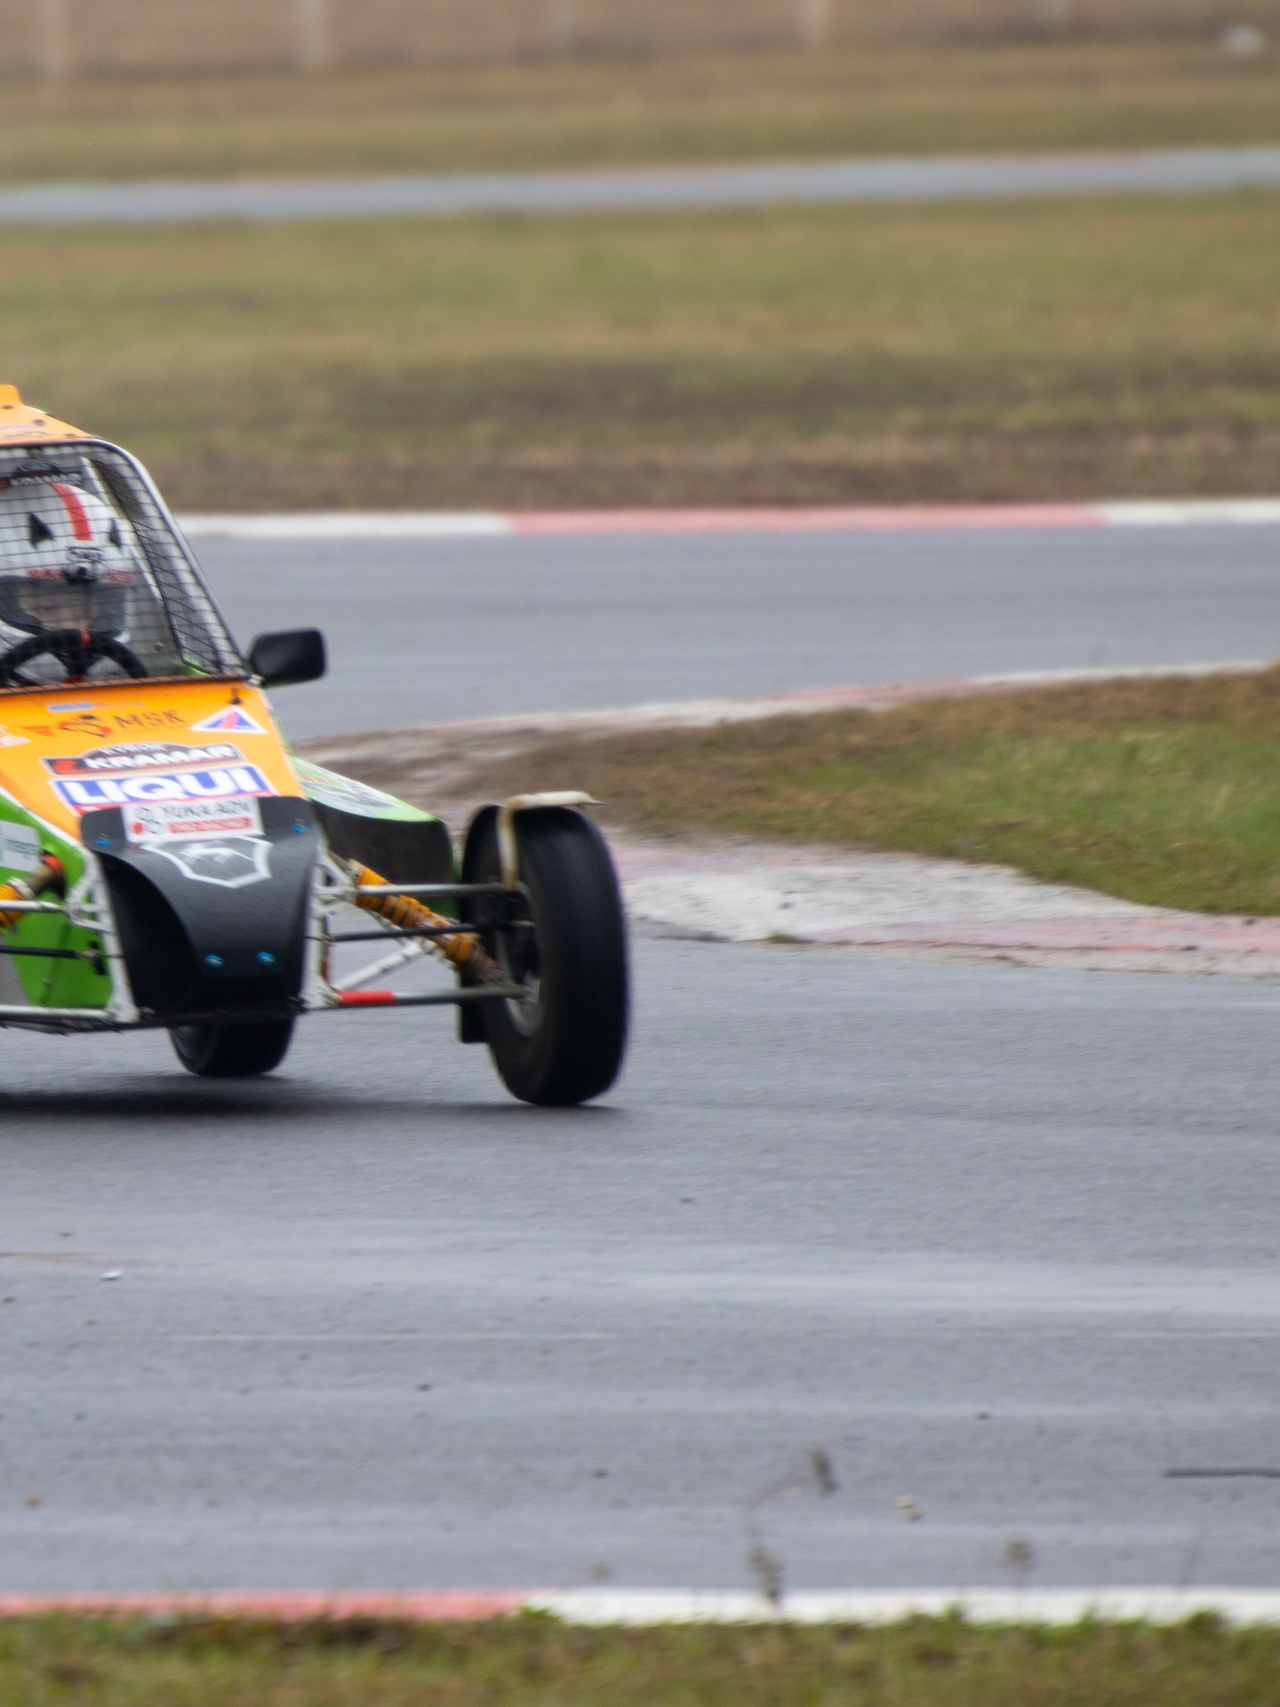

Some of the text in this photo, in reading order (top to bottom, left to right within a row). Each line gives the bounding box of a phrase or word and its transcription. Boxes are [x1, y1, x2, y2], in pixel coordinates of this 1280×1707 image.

[113, 709, 186, 730] MSK
[83, 745, 238, 770] KRAMAR
[61, 765, 264, 805] LIQUI
